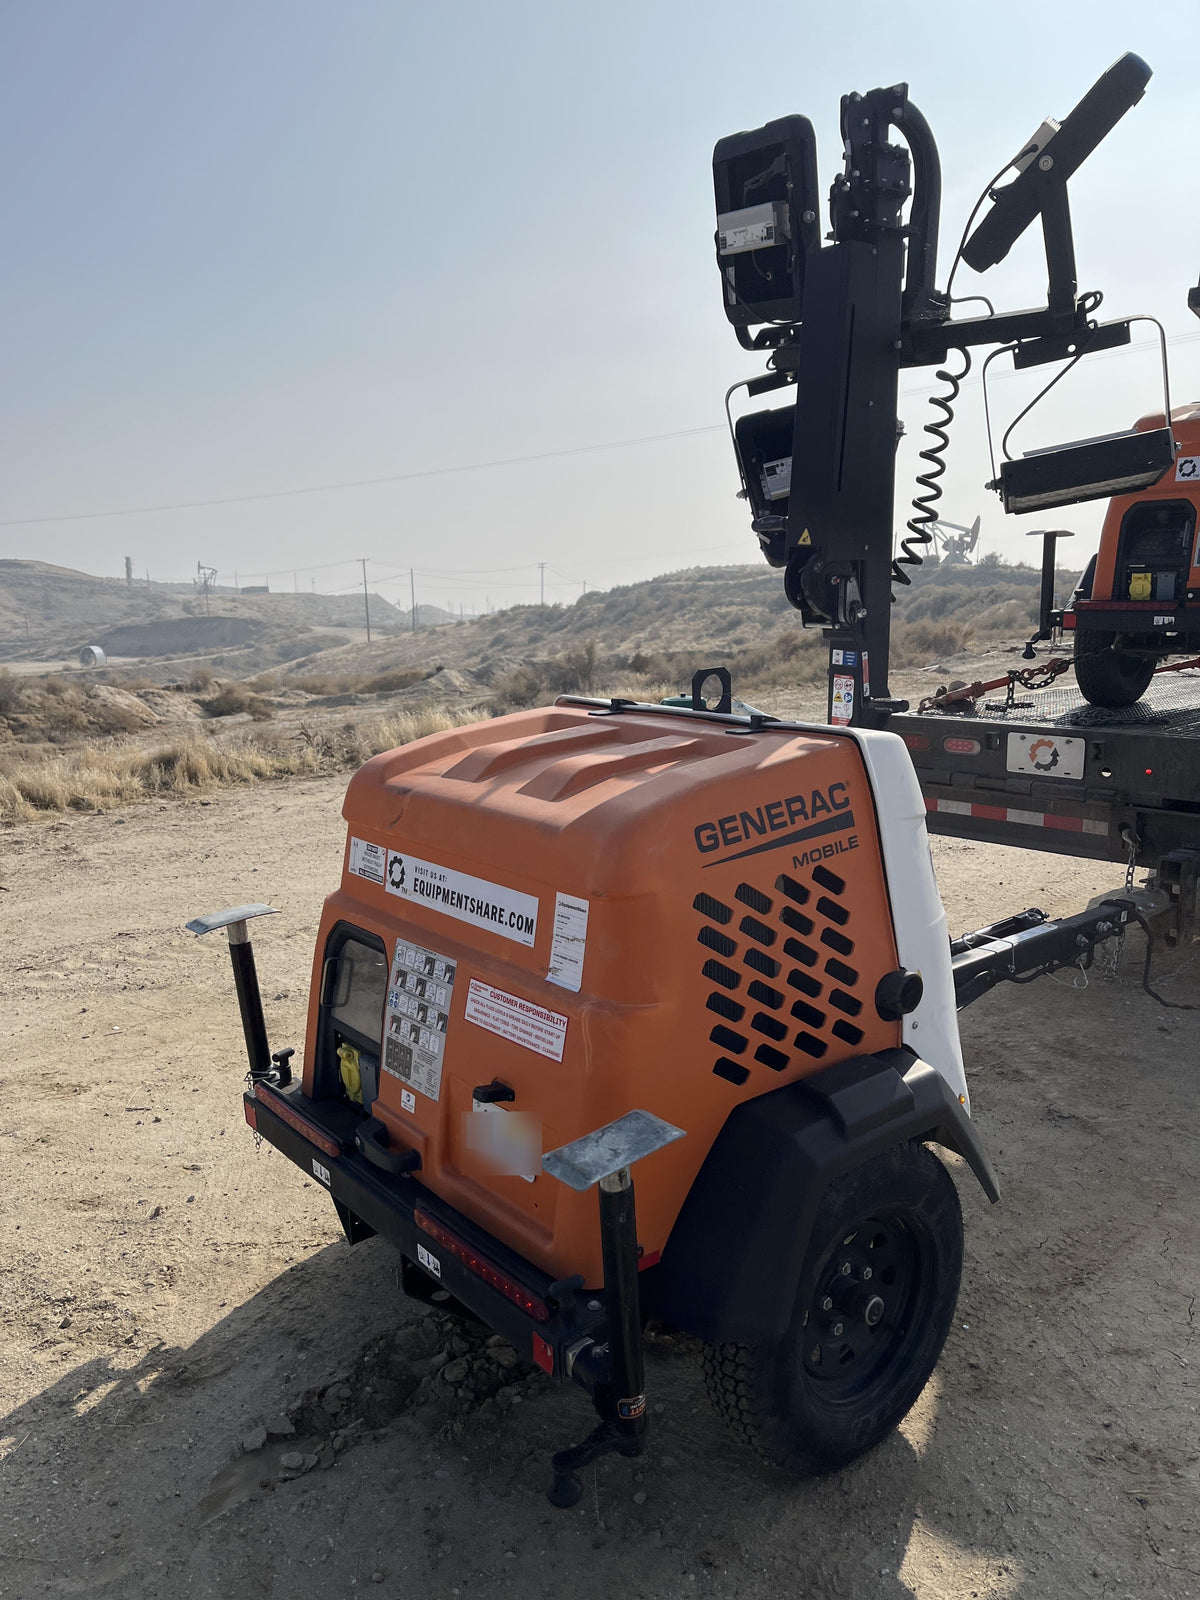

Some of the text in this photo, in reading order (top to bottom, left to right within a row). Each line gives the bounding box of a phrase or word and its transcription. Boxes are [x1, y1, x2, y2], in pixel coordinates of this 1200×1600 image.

[694, 782, 850, 853] GENERAC
[792, 835, 859, 869] MOBILE
[414, 866, 448, 882] VISIT US AT:
[413, 877, 534, 936] EQUIPMENTSHARE.COM
[490, 991, 566, 1028] CUSTOMER RESPONSIBILITY
